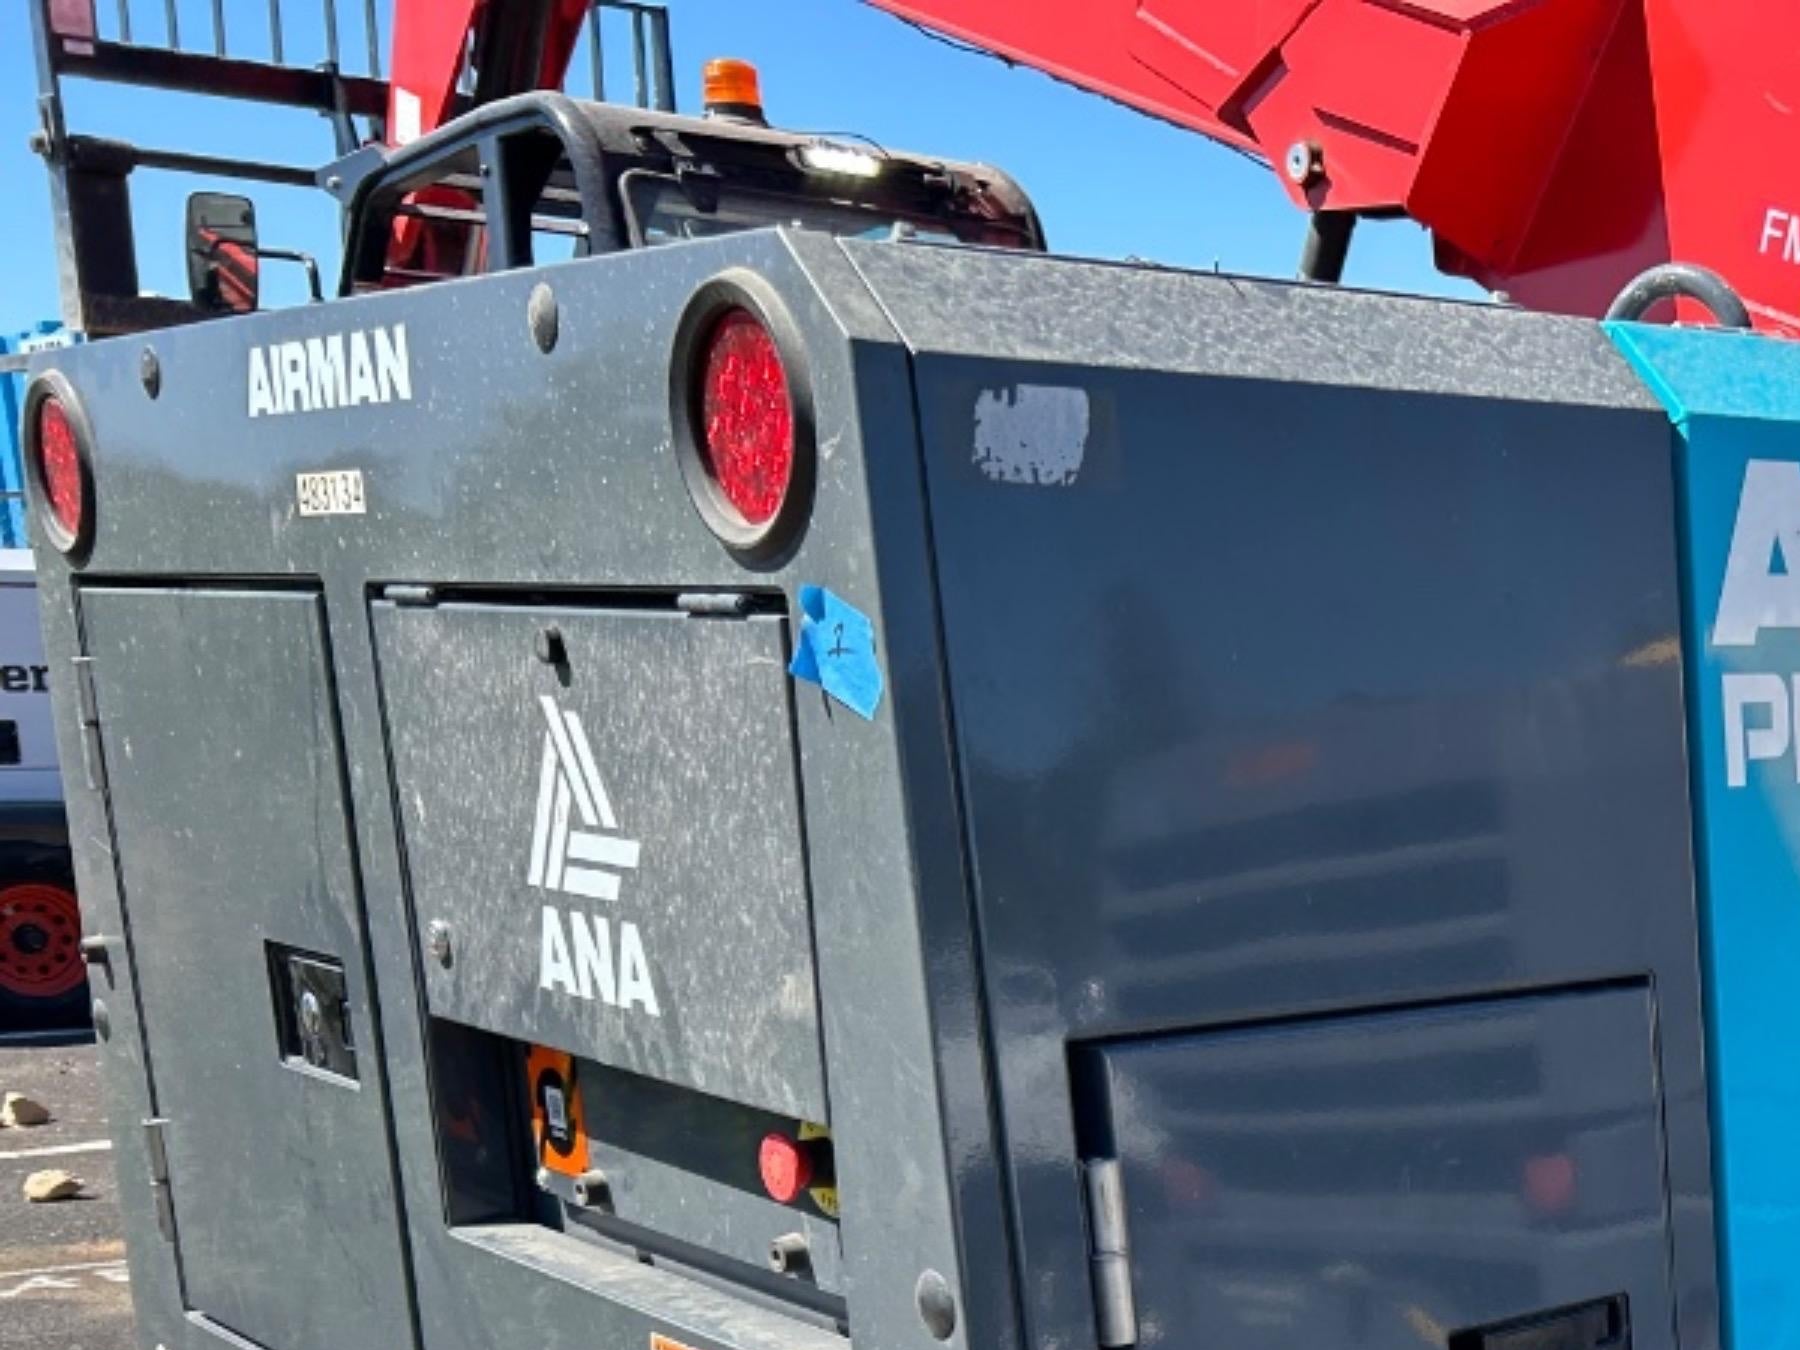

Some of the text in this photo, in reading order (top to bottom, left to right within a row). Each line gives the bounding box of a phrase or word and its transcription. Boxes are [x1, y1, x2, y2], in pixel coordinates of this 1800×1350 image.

[248, 322, 411, 418] AIRMAN
[301, 473, 362, 511] 483134
[540, 905, 661, 1018] ANA
